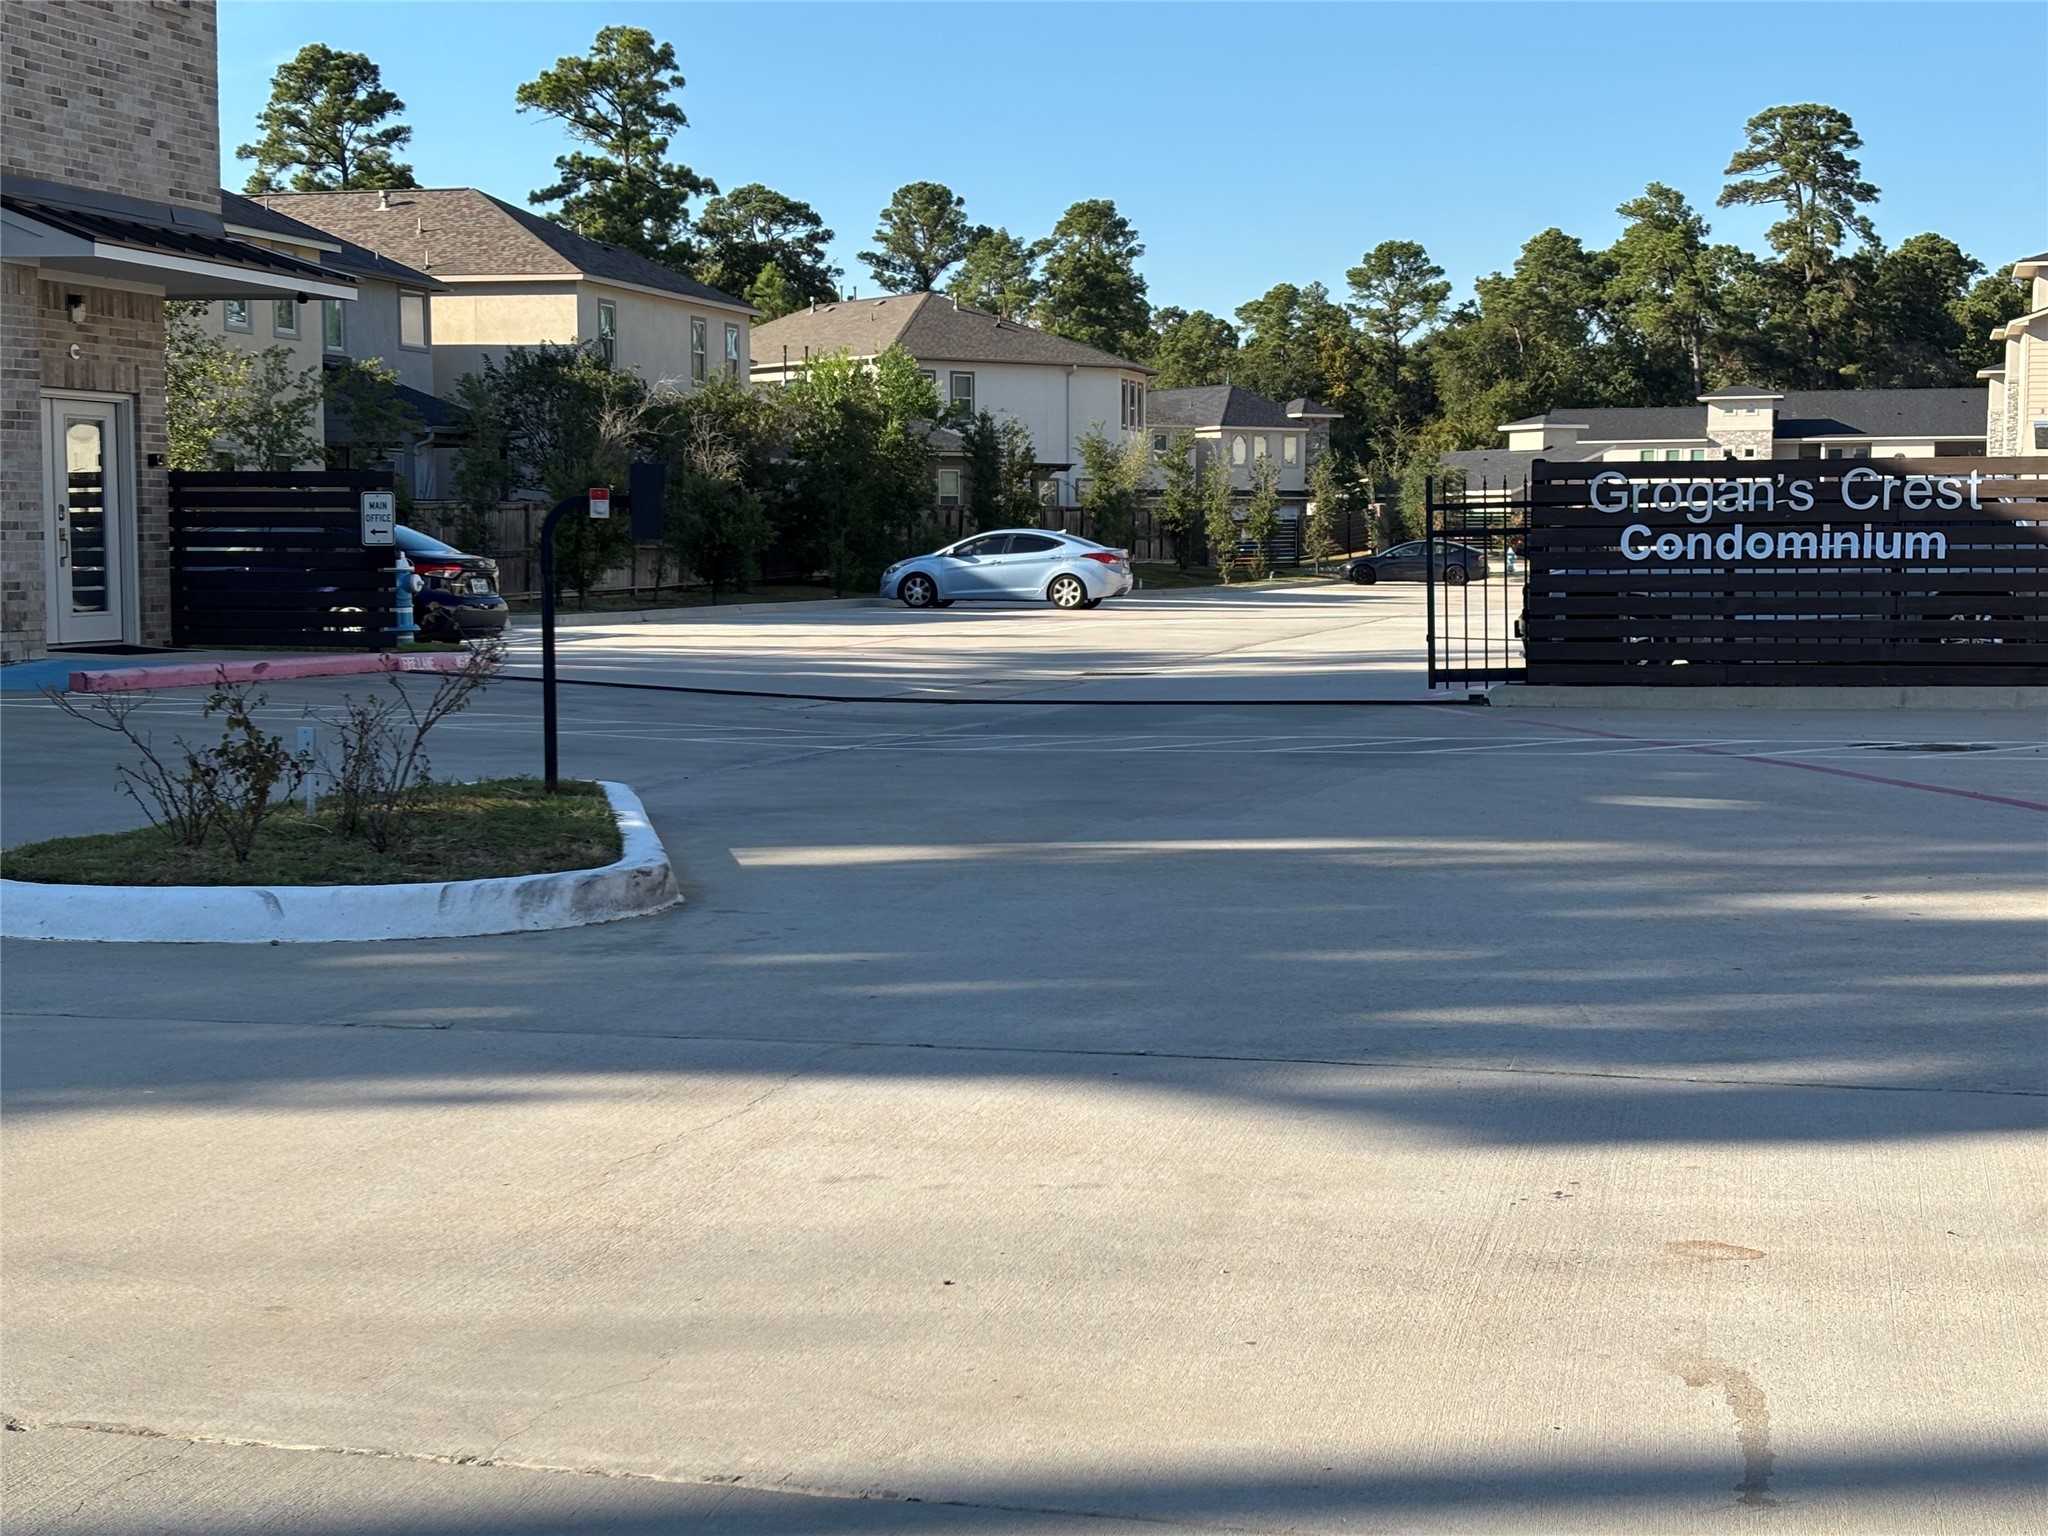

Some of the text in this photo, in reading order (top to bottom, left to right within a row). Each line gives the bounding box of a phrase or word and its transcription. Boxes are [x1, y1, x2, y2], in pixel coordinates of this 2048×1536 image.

[369, 501, 387, 509] MAIN
[1590, 467, 1982, 523] Grogan’s Crest
[366, 513, 391, 522] OFFICE
[1620, 524, 1946, 560] Condominium
